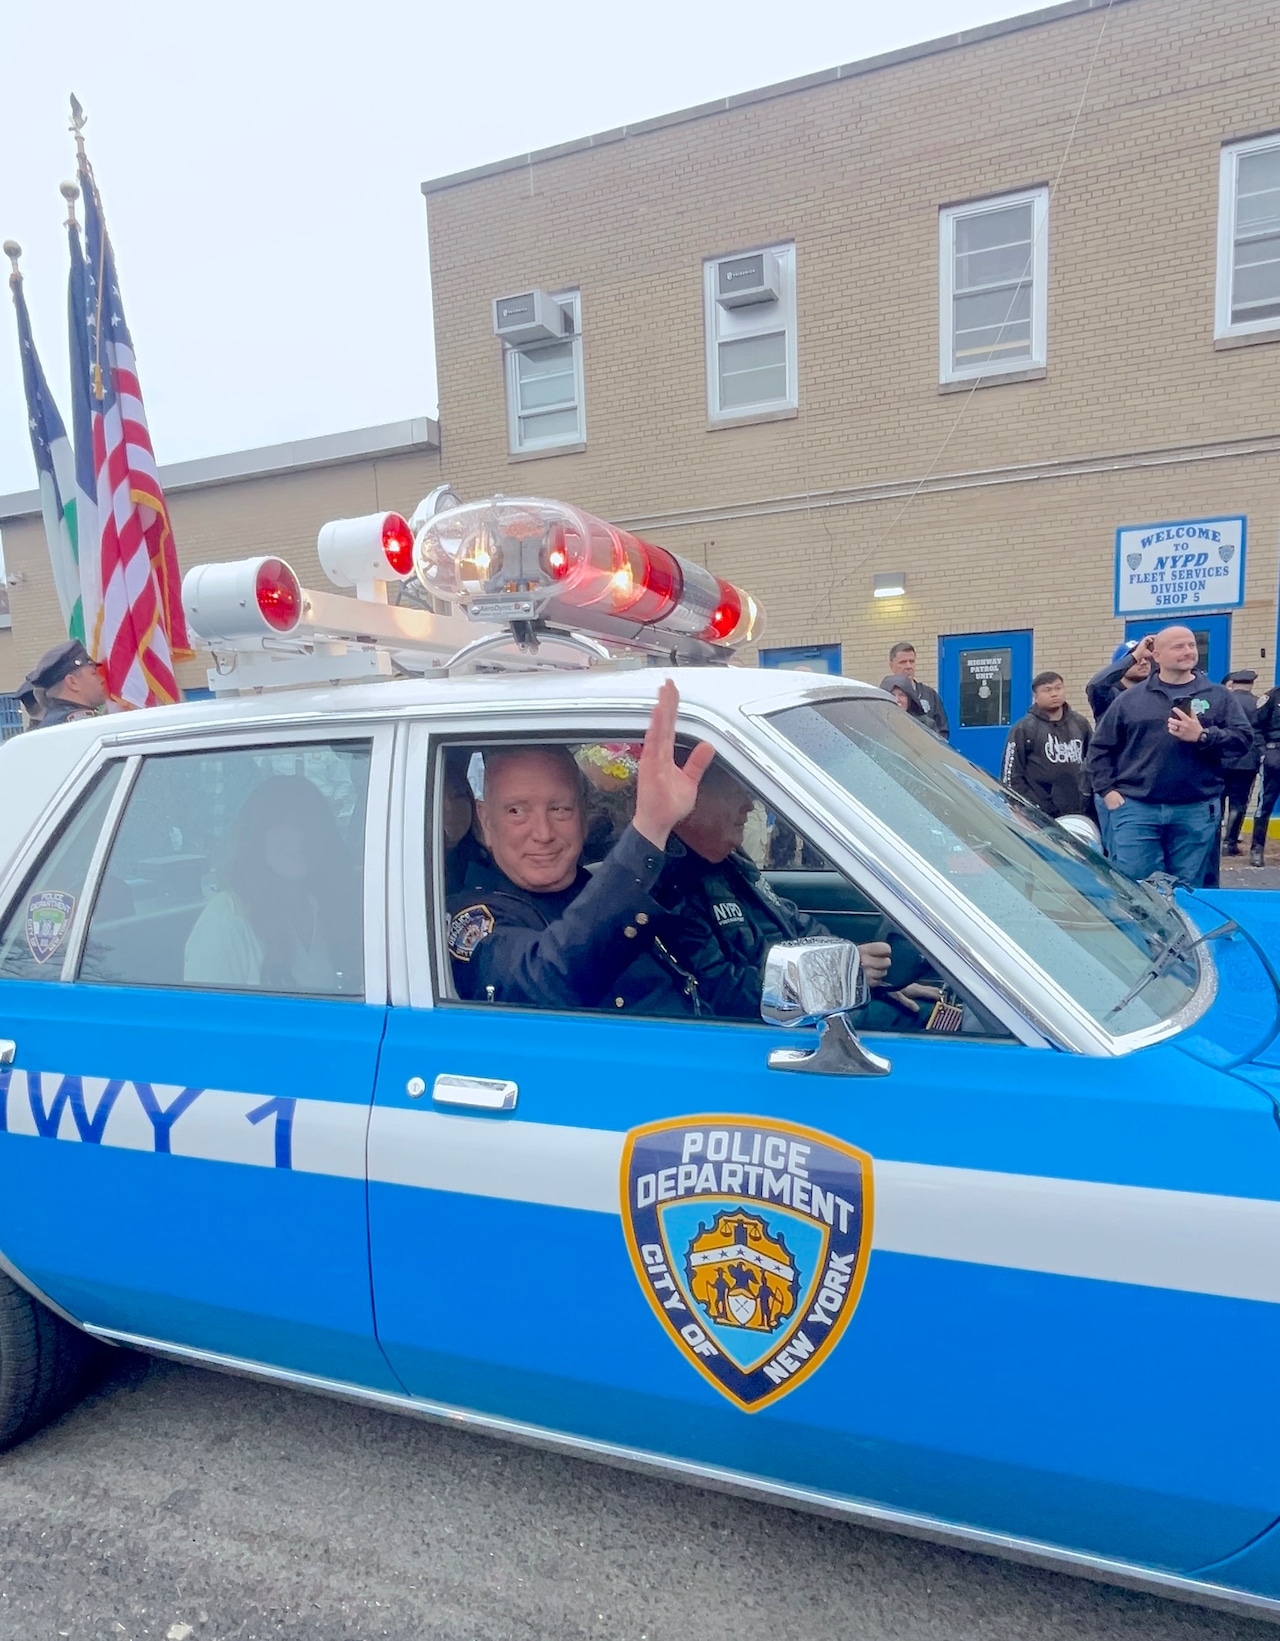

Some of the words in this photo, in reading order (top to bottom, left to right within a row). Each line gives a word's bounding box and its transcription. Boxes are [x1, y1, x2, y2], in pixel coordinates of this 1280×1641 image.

[1140, 526, 1221, 549] WELCOME
[1173, 542, 1189, 551] TO
[1153, 552, 1209, 570] NYPD
[1129, 571, 1166, 585] FLEET
[1171, 565, 1229, 581] SERVICES
[1151, 580, 1206, 595] DIVISION
[1156, 593, 1188, 606] SHOP
[1193, 592, 1201, 603] 5
[967, 657, 1002, 666] HIGHWAY
[970, 665, 999, 673] PATROL
[975, 672, 994, 680] UNIT
[713, 902, 743, 920] NYPD
[245, 1095, 297, 1170] 1
[681, 1131, 811, 1178] POLICE
[637, 1163, 855, 1234] DEPARTMENT
[641, 1243, 687, 1311] CITY
[681, 1323, 719, 1357] OF
[763, 1330, 816, 1384] NEW
[807, 1250, 855, 1326] YORK
